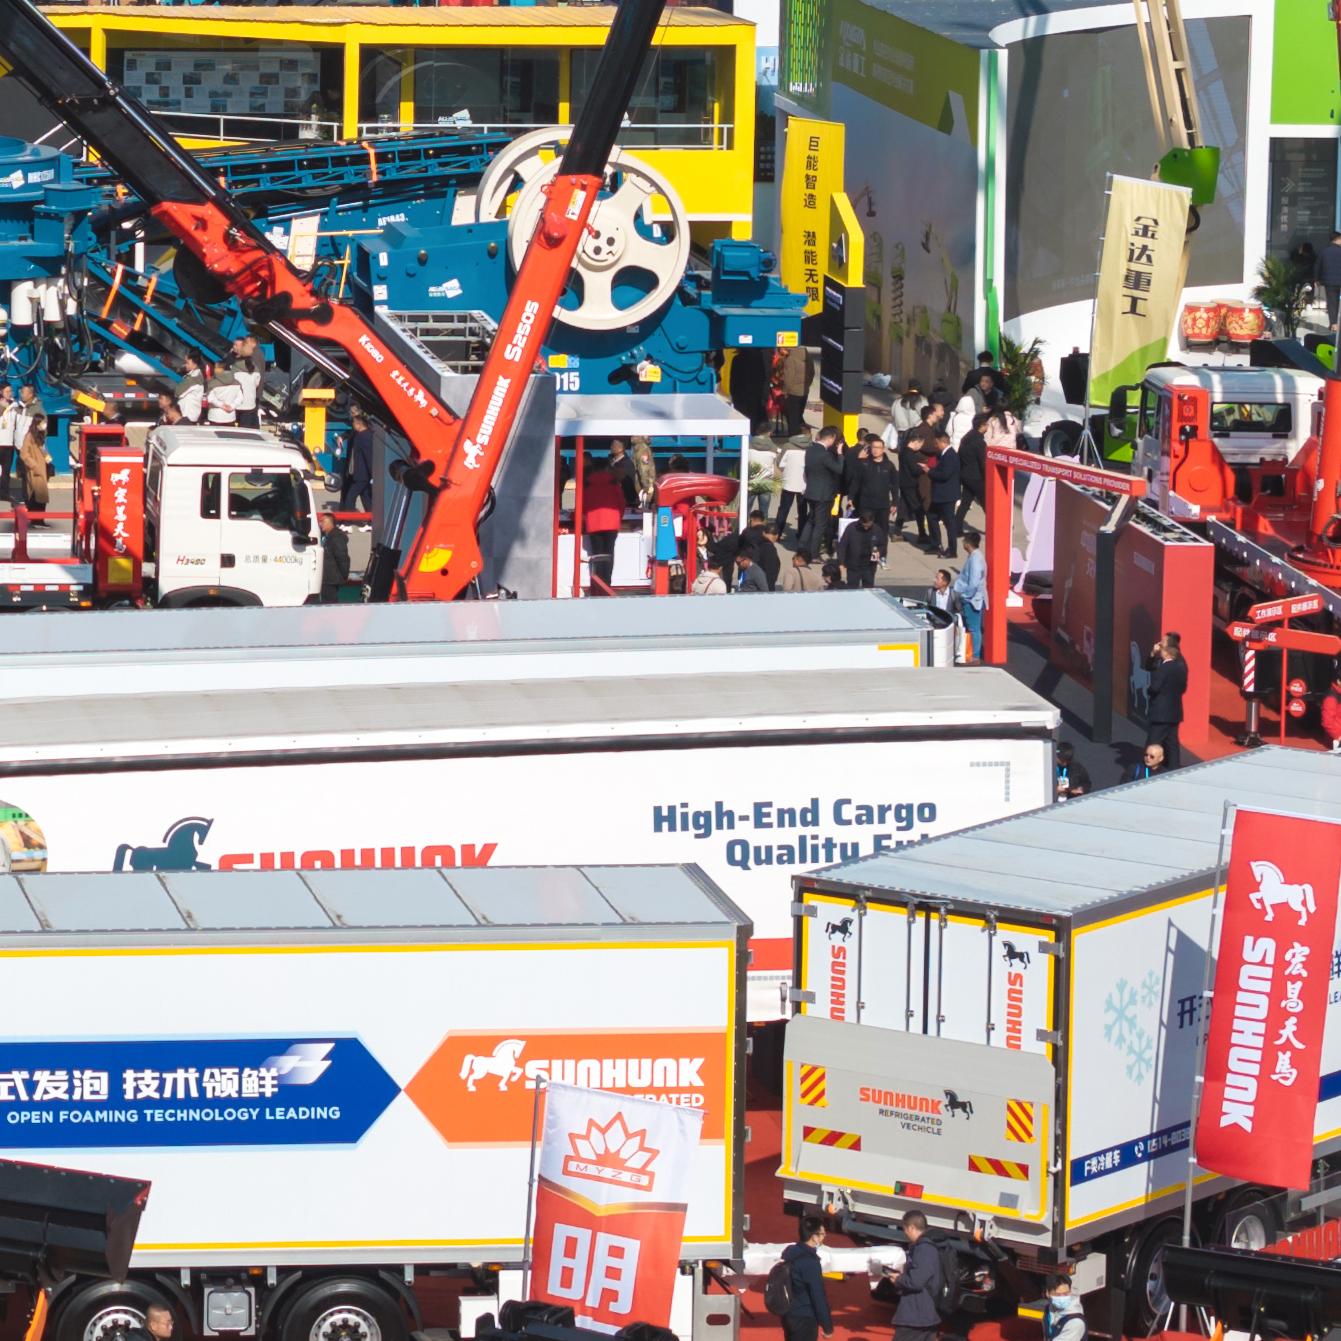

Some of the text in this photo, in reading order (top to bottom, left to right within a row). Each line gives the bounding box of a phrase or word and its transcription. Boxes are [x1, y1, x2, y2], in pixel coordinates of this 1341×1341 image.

[802, 135, 821, 304] 巨能智造 潜能无限
[1121, 215, 1160, 318] 金达重工
[475, 375, 511, 446] SUNHUNK
[987, 451, 1131, 492] GLOBAL SPECIALIZED TRANSPORT SOLUTIONS PROVIDER
[652, 797, 937, 840] High-End Cargo
[725, 834, 860, 871] Quality
[1219, 934, 1277, 1134] SUNHUNK
[122, 1066, 281, 1100] 技术领鲜
[524, 1057, 706, 1090] SUNHUNK
[5, 1105, 341, 1125] OPEN FOAMING TECHNOLOGY LEADING
[859, 1086, 943, 1116] SUNHUNK
[878, 1107, 943, 1127] REFRIGERATED
[573, 1161, 643, 1186] MYZG
